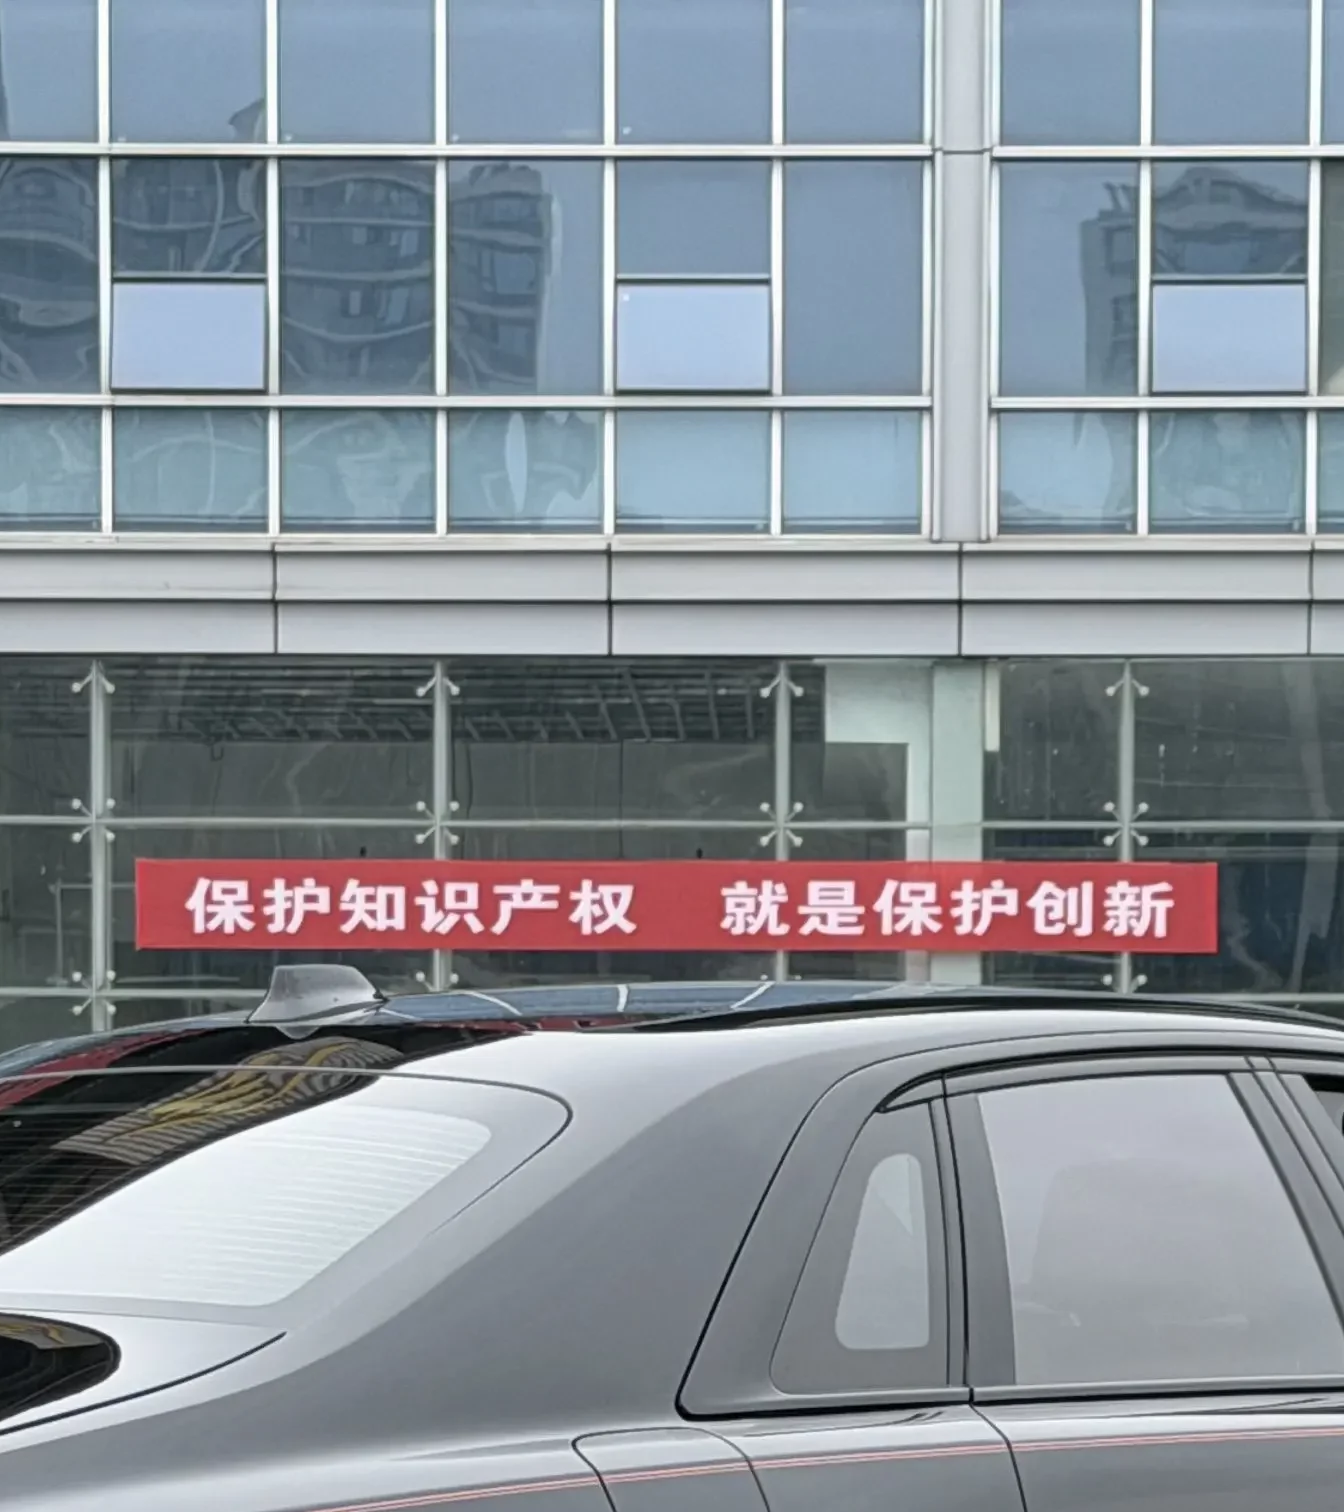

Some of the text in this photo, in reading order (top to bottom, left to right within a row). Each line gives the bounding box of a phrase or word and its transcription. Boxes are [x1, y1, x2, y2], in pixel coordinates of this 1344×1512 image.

[184, 876, 1176, 939] 保护知识产权 就是保护创新
